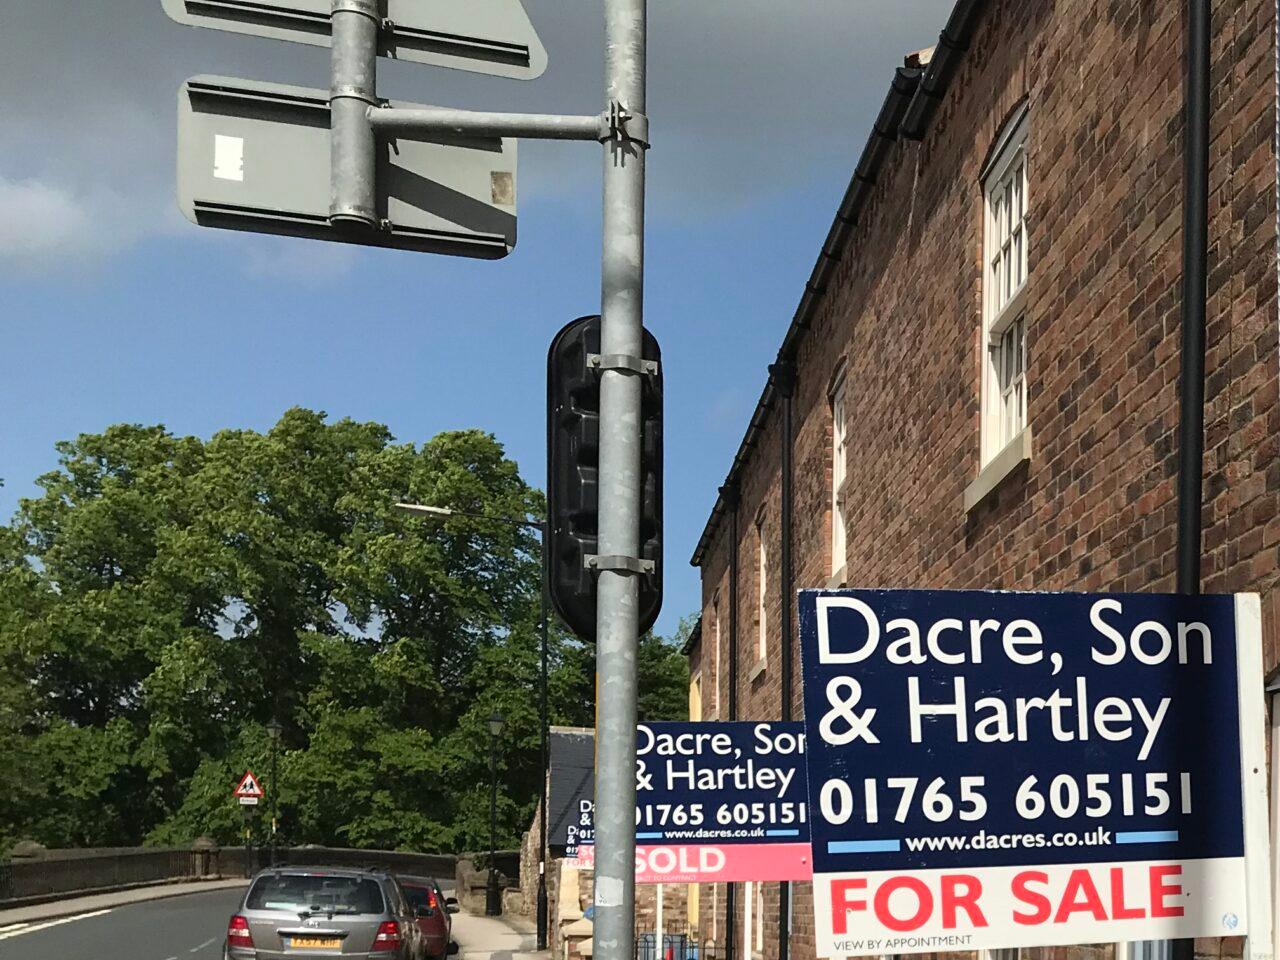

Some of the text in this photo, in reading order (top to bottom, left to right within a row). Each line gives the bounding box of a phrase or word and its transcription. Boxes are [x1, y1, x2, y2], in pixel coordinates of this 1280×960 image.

[816, 597, 1212, 675] Dacre, Son
[819, 676, 1171, 760] & Hartley
[666, 759, 796, 798] Hartley
[716, 802, 806, 825] 605151
[820, 773, 1191, 824] 01765 605151
[665, 827, 764, 839] www.dacres.co.uk
[905, 827, 1111, 851] www.dacres.co.uk
[831, 865, 1184, 933] FOR SALE
[834, 935, 972, 951] VIEW BY APPOINTMENT
